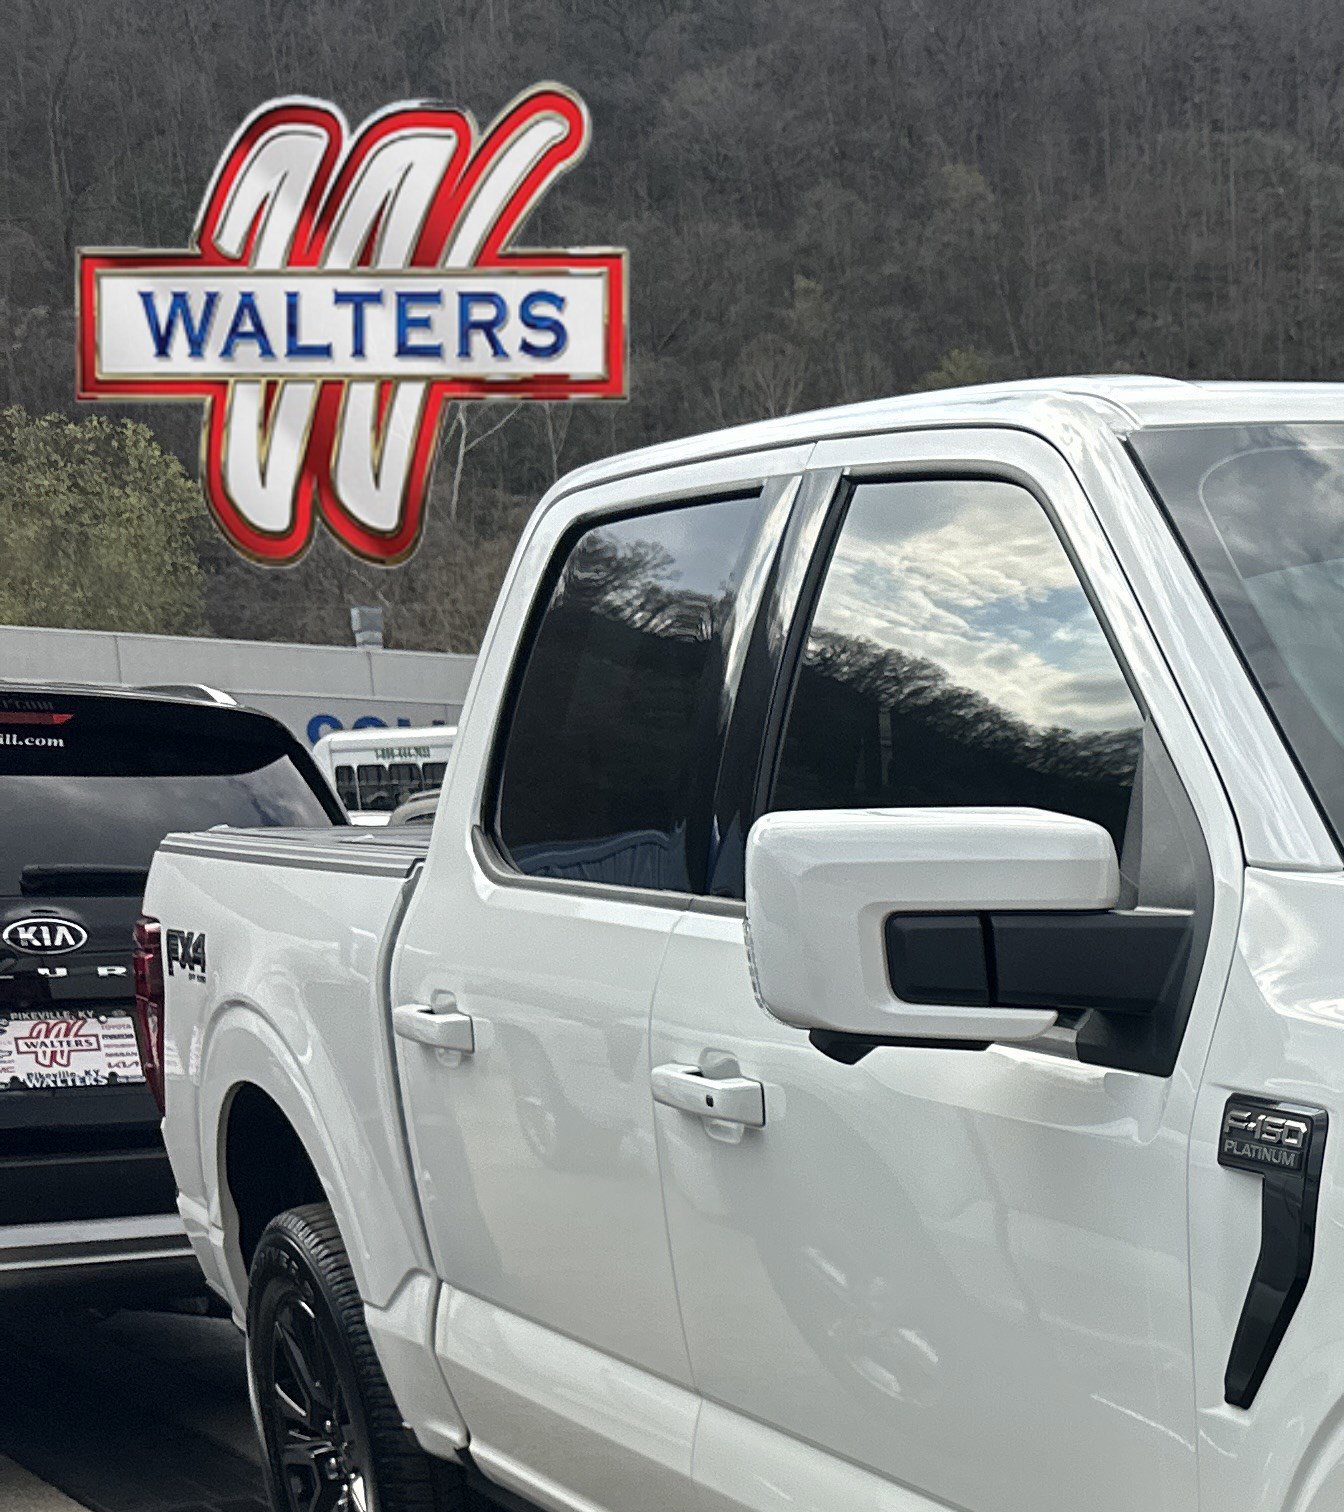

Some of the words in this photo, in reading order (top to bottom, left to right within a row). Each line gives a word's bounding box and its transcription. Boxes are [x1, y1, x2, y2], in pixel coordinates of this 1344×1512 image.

[17, 925, 76, 947] KIA
[166, 929, 206, 977] FX4
[24, 1039, 94, 1050] WALTERS
[1223, 1110, 1308, 1148] F-150
[1224, 1140, 1297, 1167] PLATINUM
